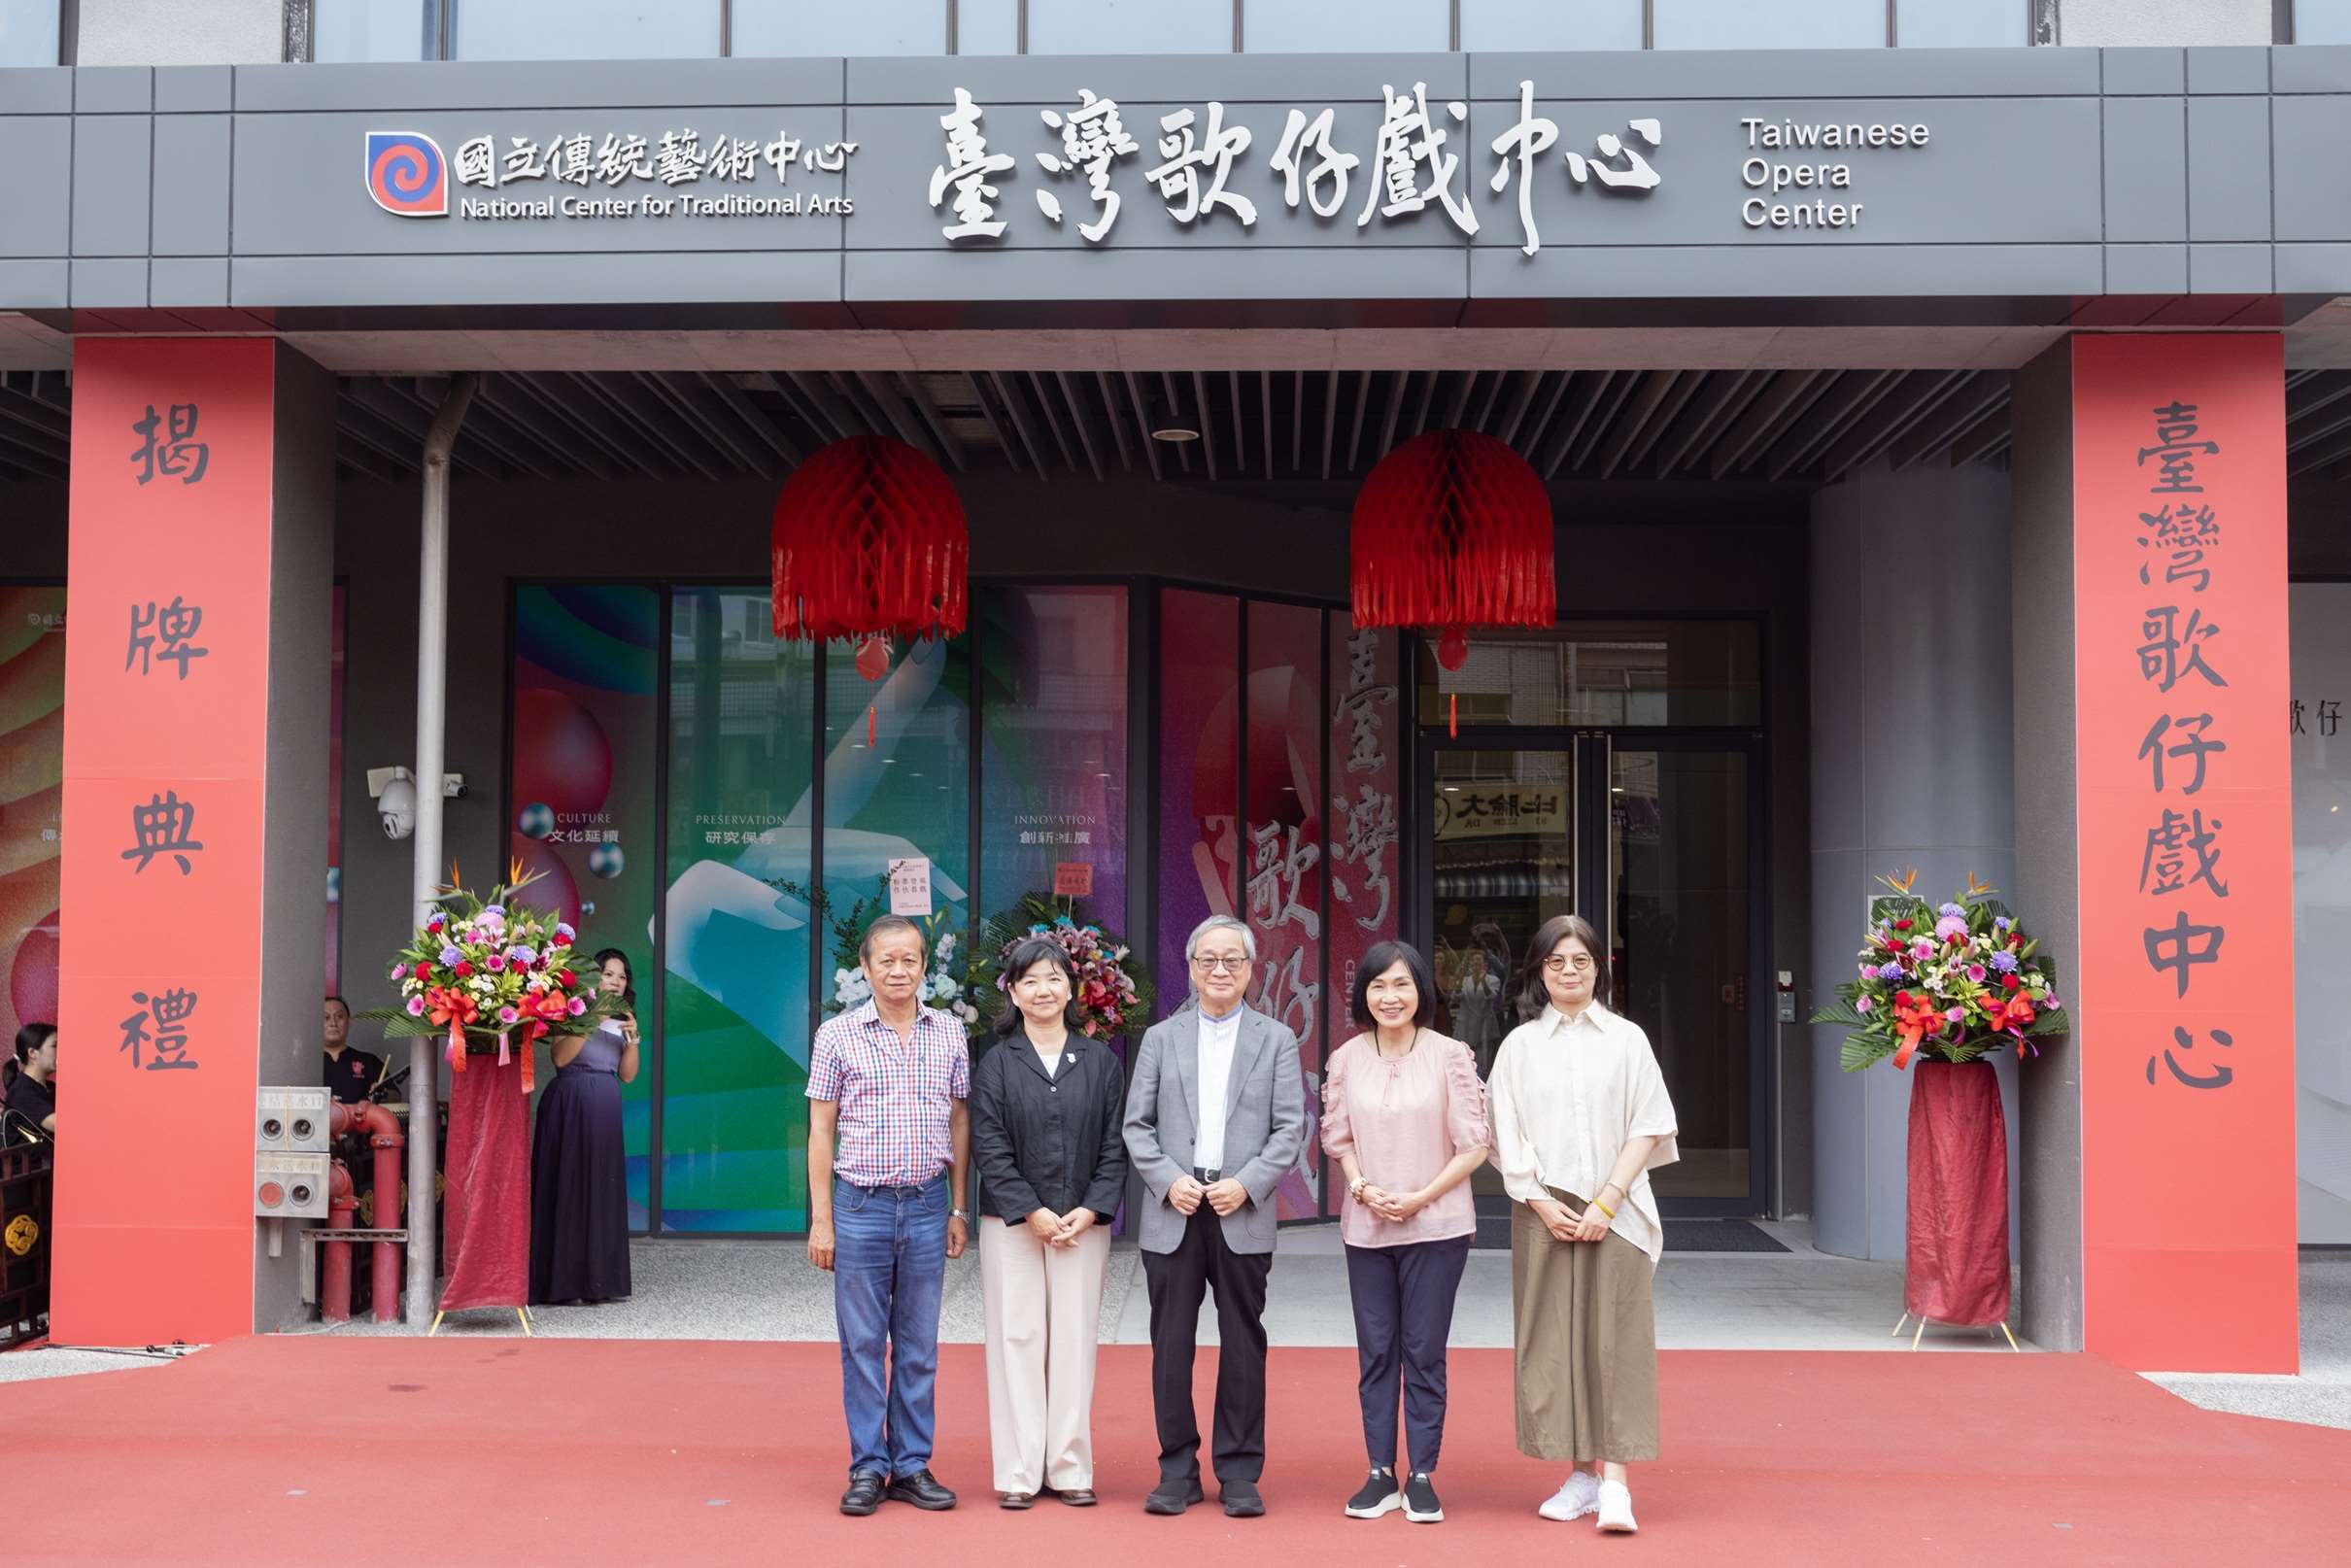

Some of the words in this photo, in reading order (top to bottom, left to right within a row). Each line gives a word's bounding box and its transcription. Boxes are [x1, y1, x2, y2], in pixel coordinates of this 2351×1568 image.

[1741, 118, 1929, 146] Taiwanese
[454, 127, 858, 187] 國立傳統藝術中心
[930, 80, 1662, 256] 臺灣歌仔戲中心
[1742, 157, 1851, 192] Opera
[460, 196, 554, 217] National
[561, 196, 637, 216] Center
[641, 193, 674, 215] for
[679, 194, 801, 214] Traditional
[807, 193, 853, 214] Arts
[1742, 198, 1863, 225] Center
[119, 403, 209, 1072] 揭牌典禮
[2137, 400, 2233, 1089] 臺灣歌仔戲中心
[558, 813, 612, 824] CULTURE
[696, 814, 786, 825] PRESERVATION
[1014, 815, 1096, 825] INNOVATION
[549, 830, 620, 843] 文化延續
[705, 831, 776, 844] 研究保存
